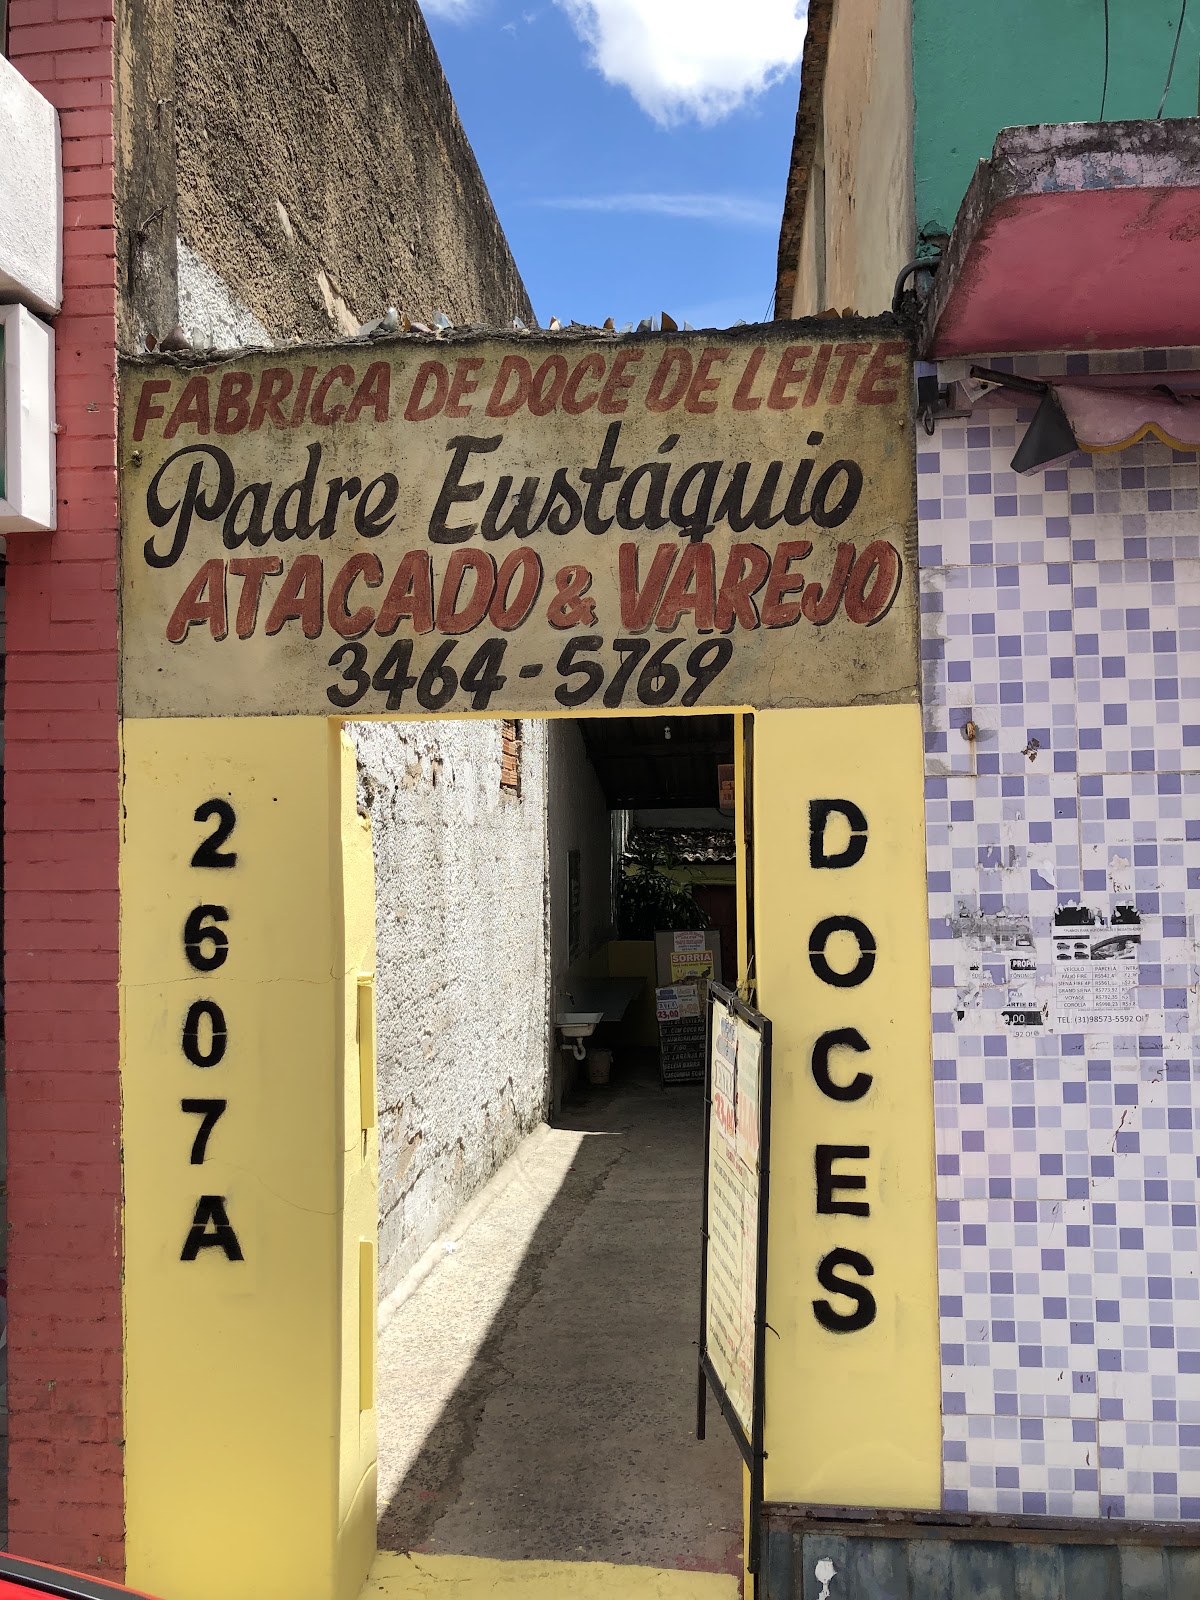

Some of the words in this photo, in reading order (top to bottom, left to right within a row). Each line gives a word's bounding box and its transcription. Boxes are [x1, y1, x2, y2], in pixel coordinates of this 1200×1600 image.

[403, 357, 481, 421] DE
[486, 347, 644, 419] DOCE
[645, 347, 730, 413] DE
[732, 341, 911, 411] LEITE
[143, 442, 400, 569] Padre
[427, 420, 864, 551] Eustáquio
[166, 546, 545, 642] ATACADO
[547, 564, 598, 628] &
[618, 540, 903, 635] VAREJO
[672, 953, 711, 962] SORRIA
[1057, 1016, 1072, 1024] TEL:
